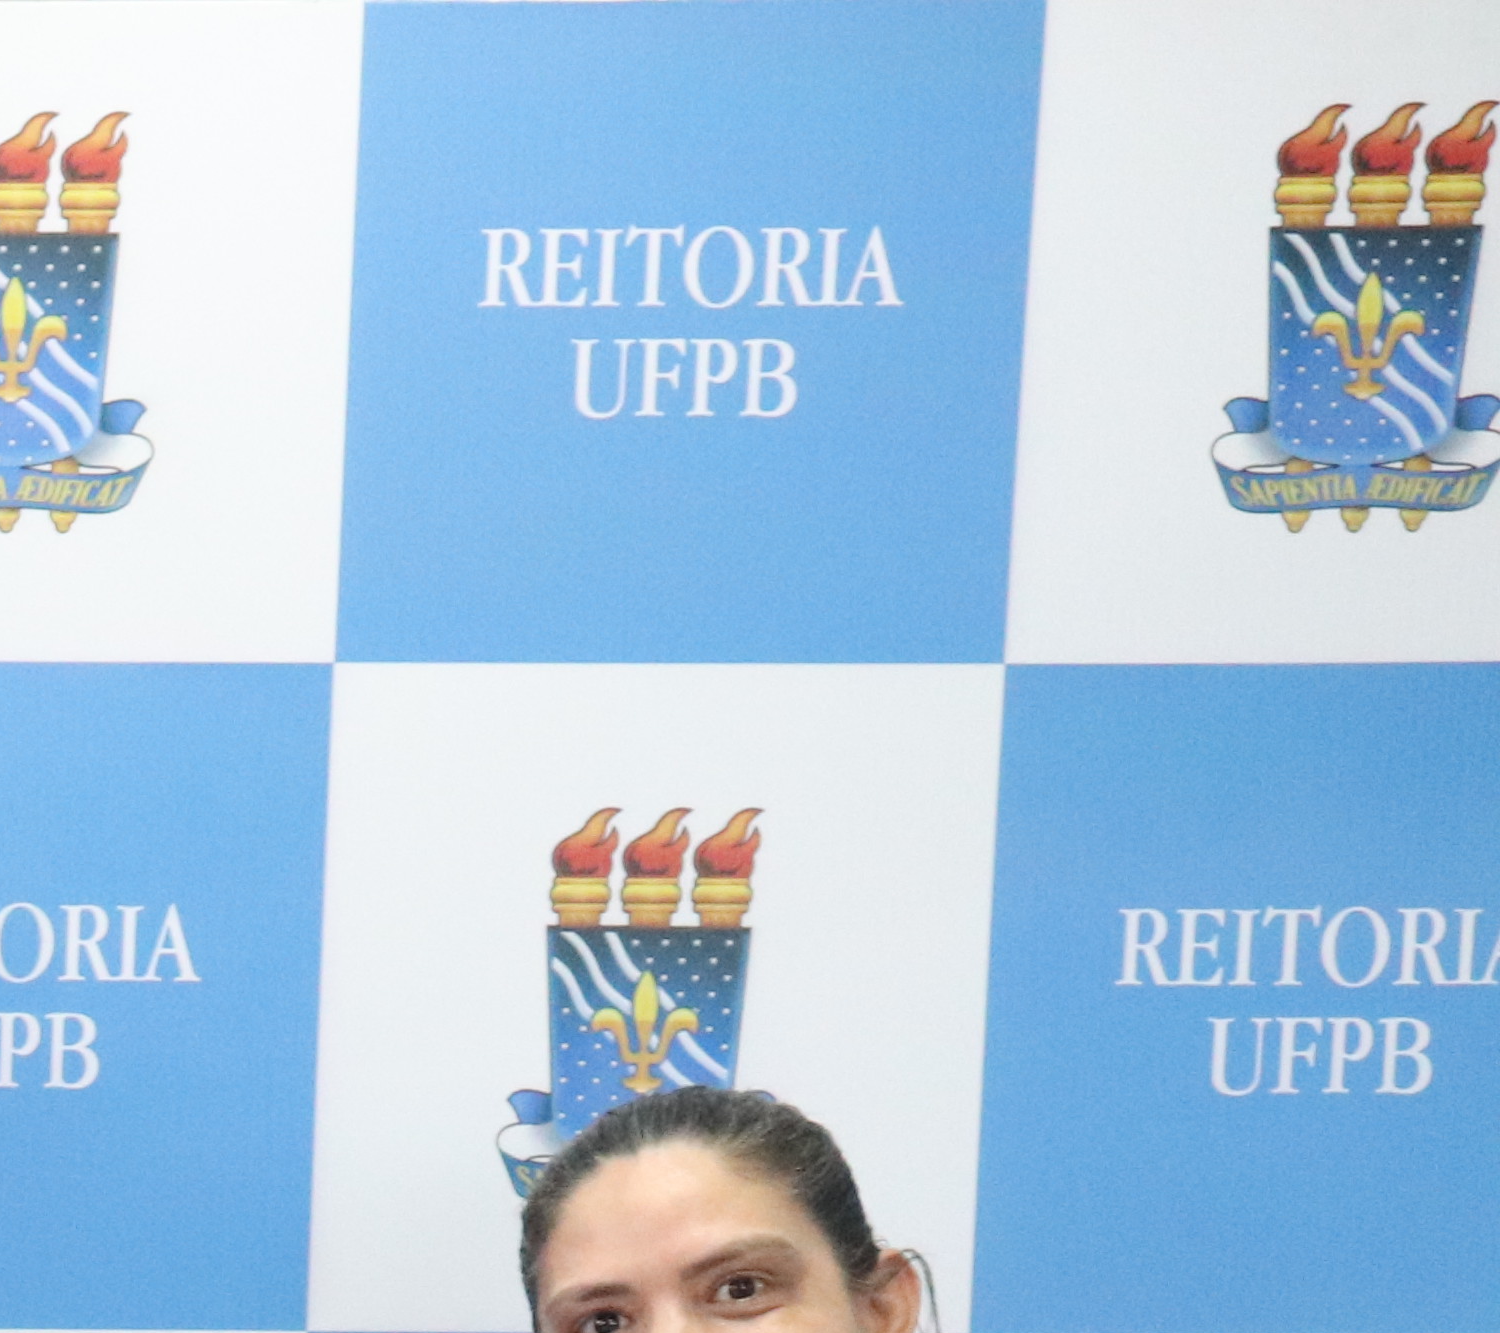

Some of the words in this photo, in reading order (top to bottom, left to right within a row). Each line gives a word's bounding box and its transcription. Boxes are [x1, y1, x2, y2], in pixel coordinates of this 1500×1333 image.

[478, 226, 903, 308] REITORIA
[572, 339, 797, 419] UFPB
[1209, 1017, 1432, 1096] UFPB
